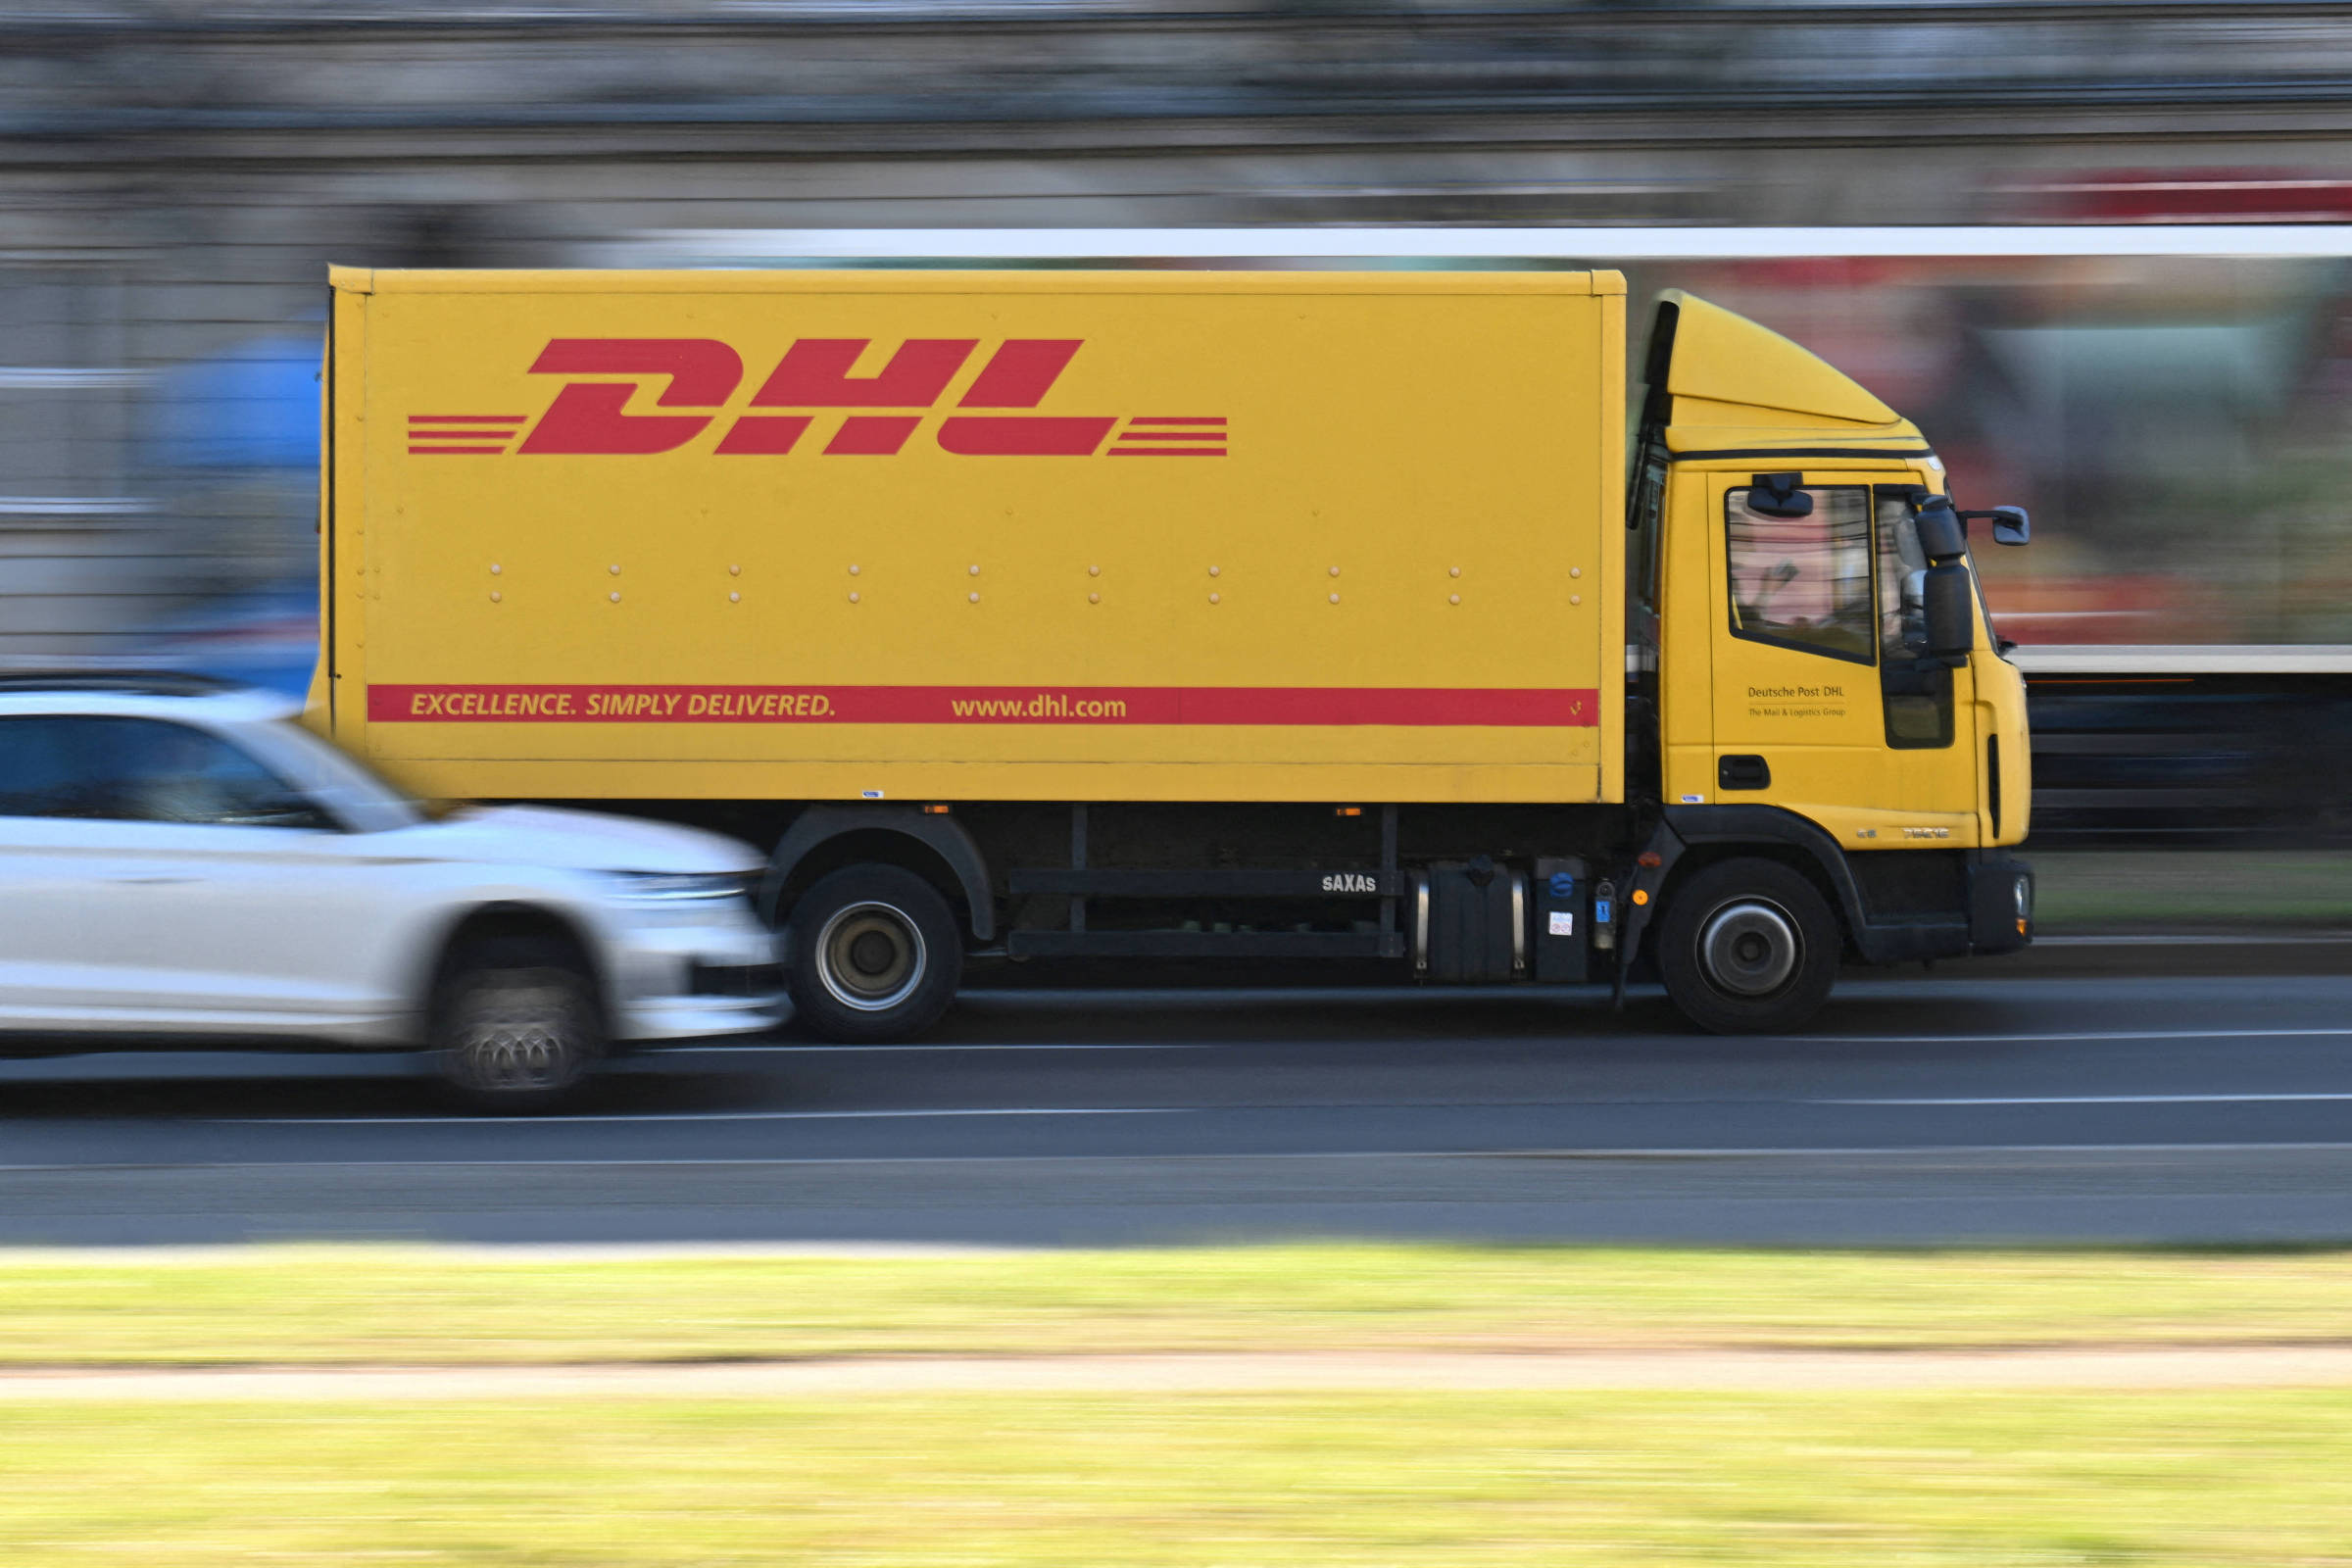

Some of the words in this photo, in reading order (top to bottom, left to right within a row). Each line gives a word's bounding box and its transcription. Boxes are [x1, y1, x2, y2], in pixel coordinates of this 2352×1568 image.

[516, 338, 1120, 456] DHL
[1748, 686, 1795, 698] Deutsche
[1798, 687, 1820, 697] Post
[1824, 686, 1844, 697] DHL
[411, 693, 576, 715] EXCELLENCE.
[586, 694, 682, 715] SIMPLY
[687, 694, 836, 716] DELIVERED.
[952, 694, 1127, 717] www.dhl.com
[1748, 709, 1762, 717] The
[1789, 708, 1822, 718] Logistics
[1823, 708, 1846, 718] Group
